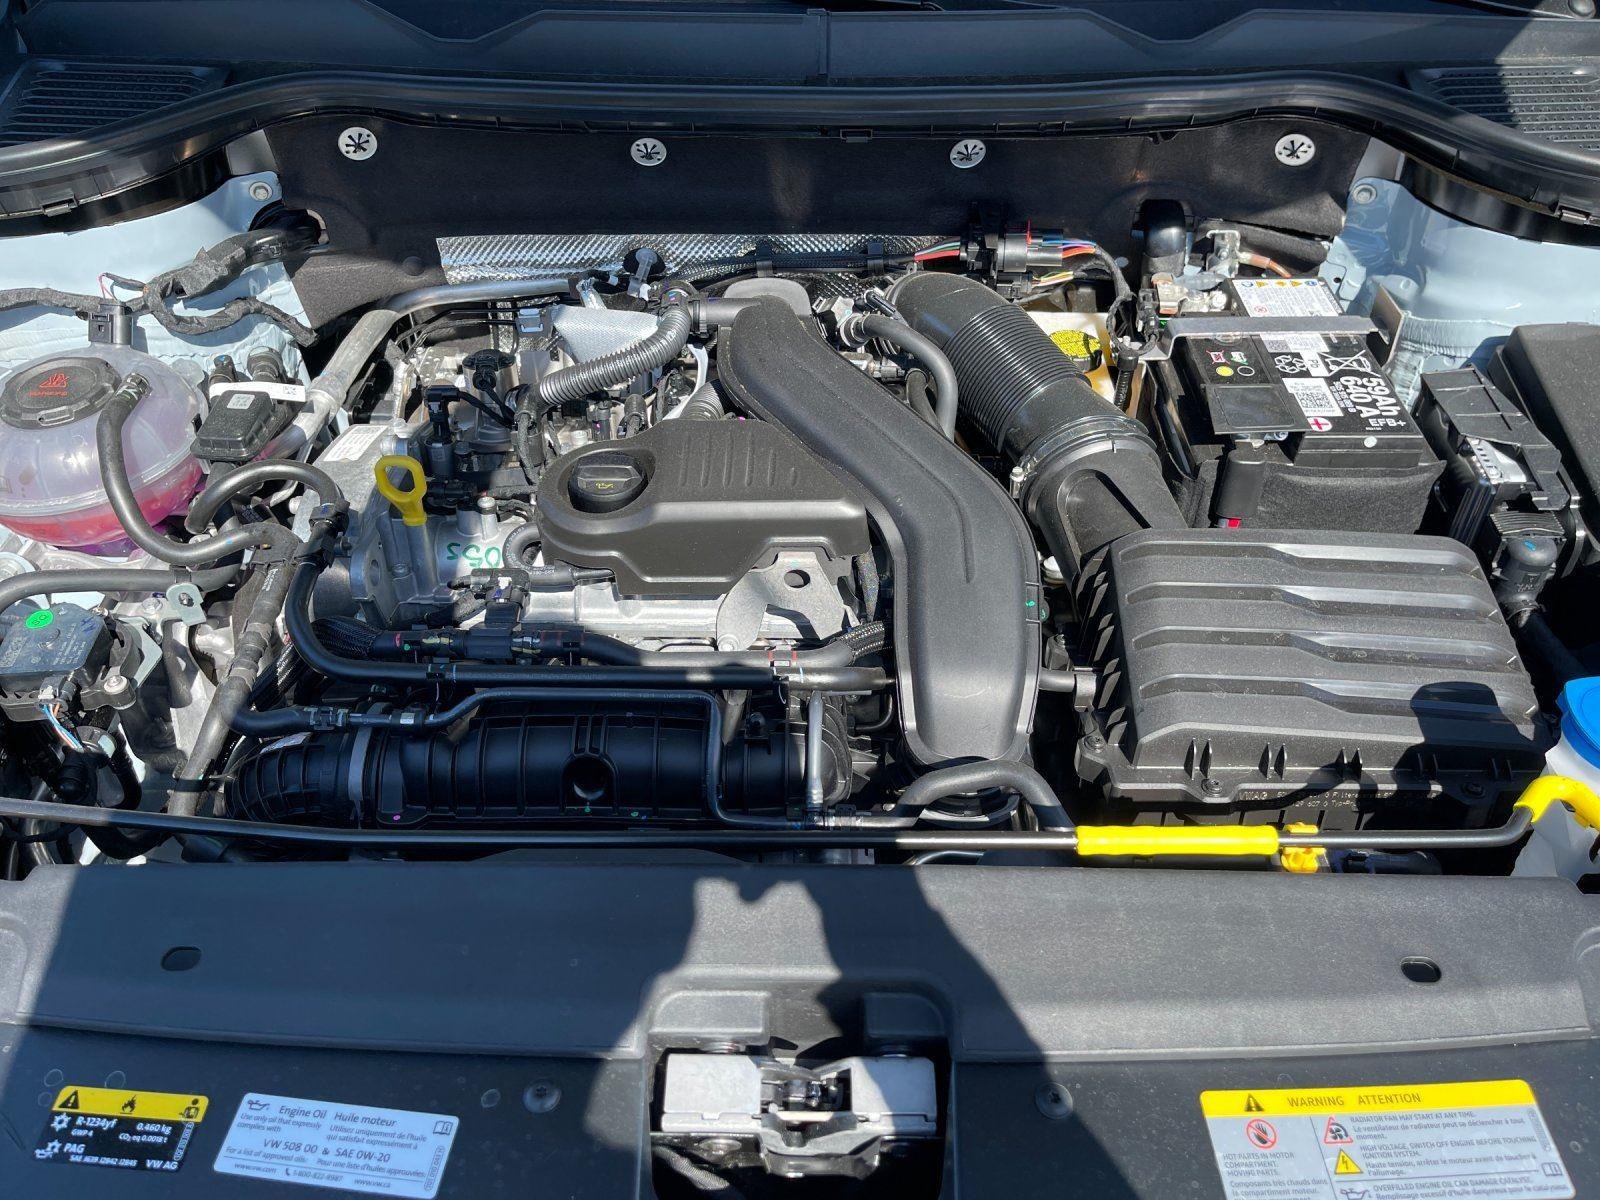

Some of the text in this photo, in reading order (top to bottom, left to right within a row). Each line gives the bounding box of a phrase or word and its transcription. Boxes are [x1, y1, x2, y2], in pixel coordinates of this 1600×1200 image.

[1340, 376, 1372, 402] 640
[1356, 406, 1380, 418] A
[1362, 378, 1401, 416] 59Ah
[1369, 418, 1406, 426] EFB+
[1287, 1093, 1421, 1107] WARNING ATTENTION
[279, 1105, 327, 1118] Engine Oil
[76, 1116, 172, 1134] R-1234yf 0.460 kg
[254, 1115, 267, 1123] only
[292, 1119, 322, 1129] expressly
[334, 1112, 398, 1126] Huile moteur
[1442, 1121, 1458, 1129] peut
[237, 1123, 265, 1131] complies
[330, 1125, 353, 1133] Utilisez
[355, 1128, 396, 1138] uniquement
[338, 1135, 365, 1143] satisfait
[1450, 1139, 1476, 1147] ENGINE
[1476, 1138, 1502, 1146] BEFORE
[63, 1143, 86, 1153] PAG
[263, 1139, 390, 1163] VW 508 00 & SAE 0W-20
[242, 1148, 253, 1156] list
[262, 1151, 293, 1161] approved
[146, 1159, 163, 1168] VW
[163, 1161, 179, 1170] AG
[316, 1158, 332, 1166] Pour
[347, 1162, 360, 1170] liste
[1230, 1180, 1271, 1189] Composants
[1373, 1183, 1414, 1192] OVERFILLED
[1241, 1188, 1291, 1197] compartiment
